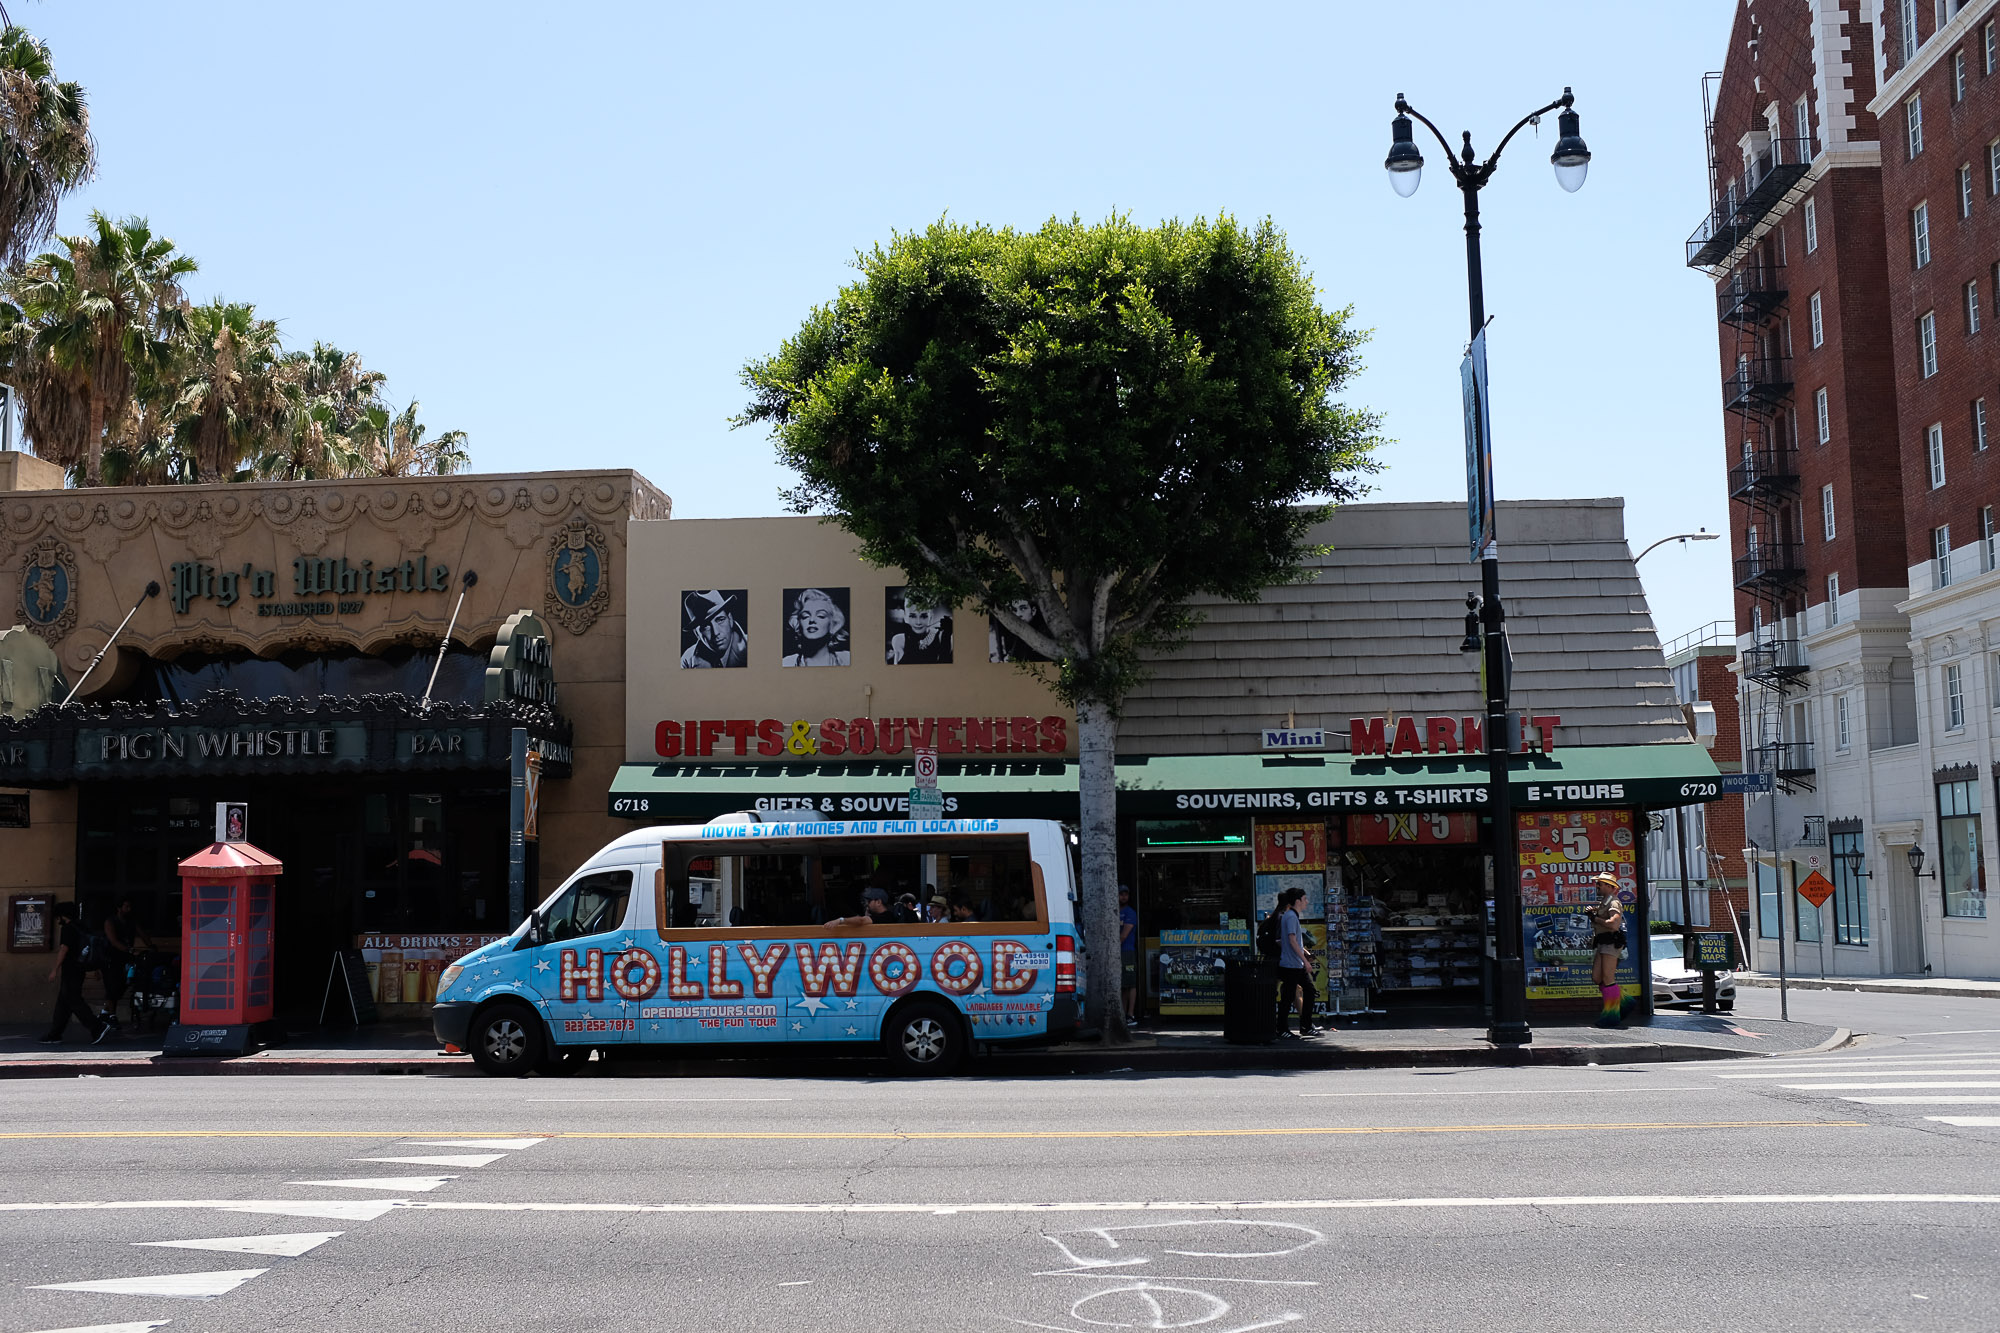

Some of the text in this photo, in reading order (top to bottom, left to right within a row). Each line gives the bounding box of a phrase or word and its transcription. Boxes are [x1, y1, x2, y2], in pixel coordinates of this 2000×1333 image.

[171, 555, 450, 615] Pig'n Whistle
[257, 601, 365, 617] ESTABLISHED 1927
[654, 716, 1067, 757] GIFTS & SOUVENIRS
[1266, 732, 1321, 746] Mini
[1350, 715, 1561, 755] MARKT
[196, 729, 335, 758] WHISTLE
[411, 735, 461, 753] BAR
[912, 790, 918, 799] 2
[1680, 783, 1717, 796] 6720
[613, 798, 649, 812] 6718
[755, 797, 813, 811] GIFTS
[820, 798, 834, 812] &
[841, 797, 958, 812] SOUVES
[1176, 788, 1488, 809] SOUVENIRS, GIFTS & T-SHIRTS
[1521, 815, 1534, 826] $5
[1553, 813, 1567, 825] $5
[1582, 812, 1596, 824] $5
[1615, 811, 1629, 823] $5
[702, 819, 998, 838] MOVIE STAR HOMES AND FILM LOCATIONS
[1274, 831, 1306, 864] $5
[1551, 827, 1591, 861] $5
[1522, 853, 1536, 865] $5
[1617, 851, 1631, 861] $5
[1540, 861, 1616, 874] SOUVENIRS
[1554, 874, 1599, 885] & Mor
[1525, 906, 1574, 916] HOLLYWOOD
[363, 937, 393, 948] ALL
[400, 936, 460, 948] DRINKS
[465, 936, 473, 946] 2
[1162, 930, 1249, 944] Tour Information
[1542, 949, 1593, 957] HOLLYWOOD
[560, 941, 1037, 1003] HOLLYWOOD
[642, 1005, 777, 1018] OPENBUSTOURS.COM
[966, 1002, 1041, 1011] LANGUAGES AVAILABLE
[564, 1020, 635, 1032] 323-252-7873
[699, 1018, 777, 1028] THE FUN TOUR
